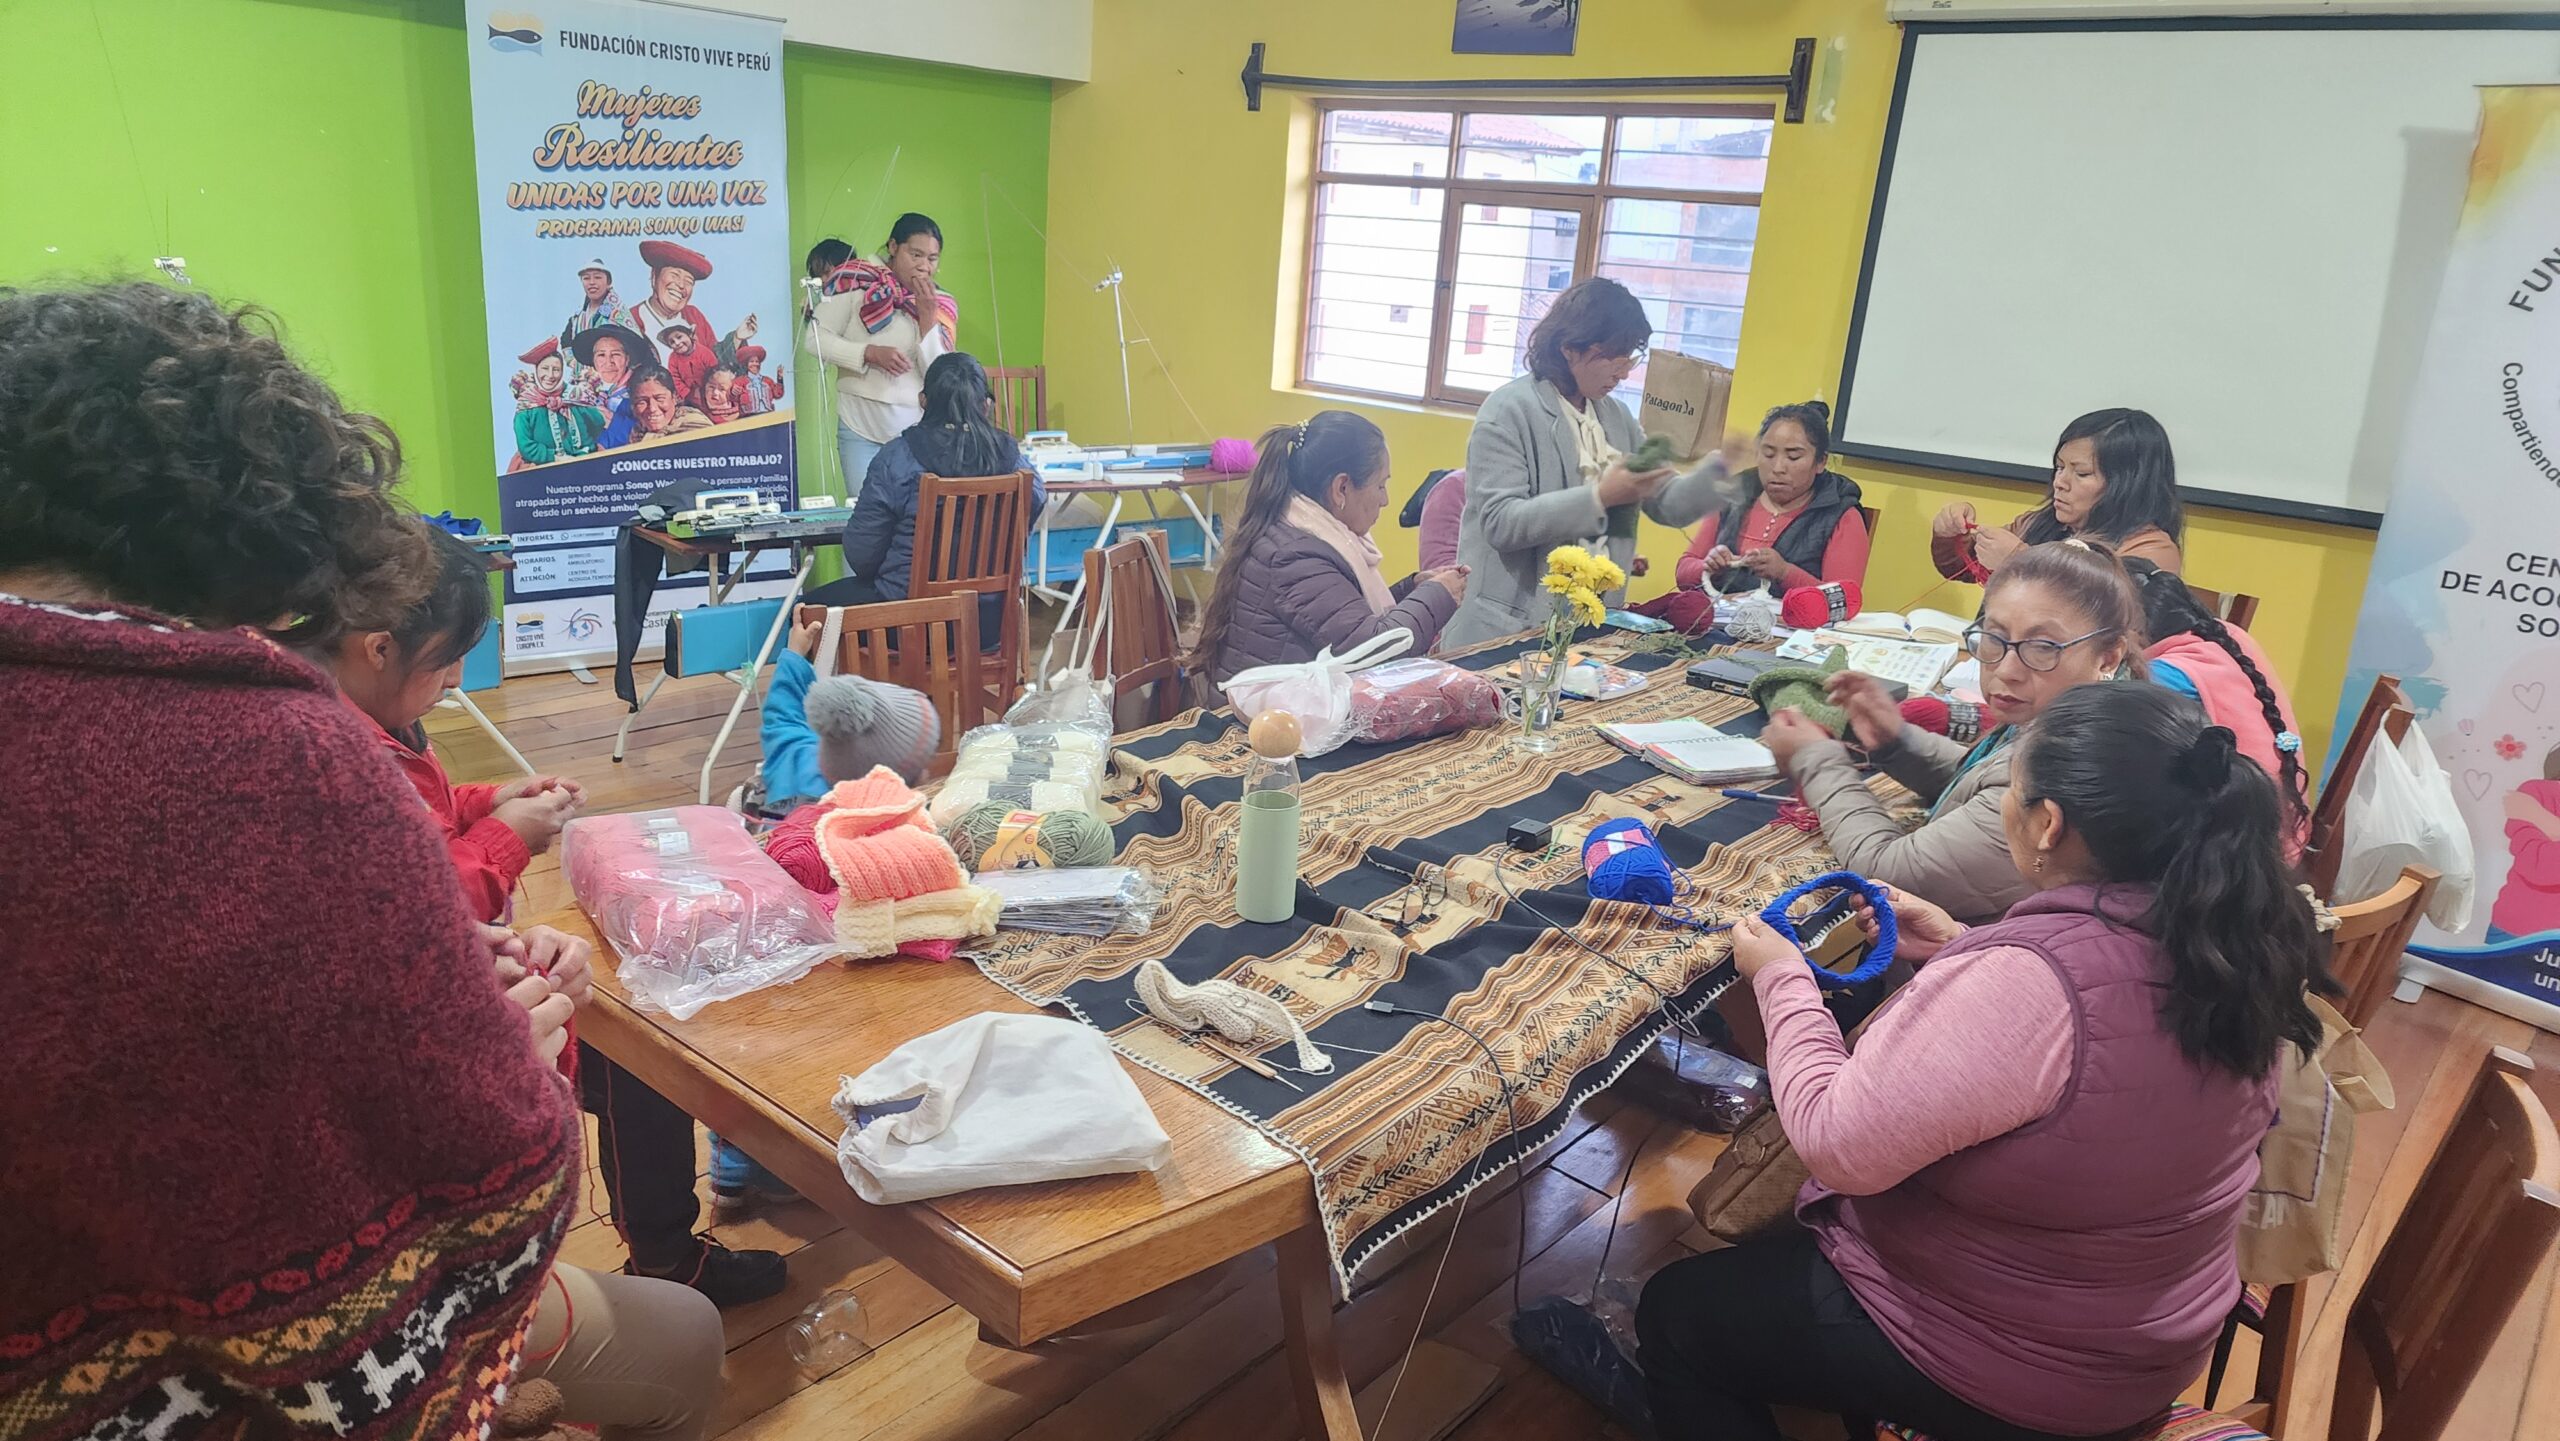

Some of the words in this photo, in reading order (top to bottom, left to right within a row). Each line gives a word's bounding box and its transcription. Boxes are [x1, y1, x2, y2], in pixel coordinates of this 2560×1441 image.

[560, 30, 646, 57] FUNDACIÓN
[650, 41, 700, 63] CRISTO
[703, 47, 734, 67] VIVE
[737, 51, 771, 71] PERÚ
[577, 79, 702, 127] Mujeres
[533, 121, 744, 170] Resilientes
[506, 181, 606, 209] UNIDAS
[610, 181, 662, 209] POR
[667, 181, 718, 207] UNA
[722, 180, 768, 205] VOZ
[536, 218, 640, 237] PROGRAMA
[644, 216, 700, 236] SONQO
[703, 215, 746, 233] WASI
[611, 459, 672, 474] ¿CONOCES
[673, 456, 727, 469] NUESTRO
[728, 453, 783, 467] TRABAJO?
[545, 485, 582, 494] Nuestro
[582, 483, 624, 494] programa
[716, 477, 752, 487] personas
[753, 477, 759, 485] y
[515, 497, 560, 508] atrapadas
[561, 496, 577, 506] por
[578, 494, 609, 504] hechos
[610, 492, 622, 501] de
[532, 508, 559, 518] desde
[561, 507, 573, 516] un
[574, 504, 609, 515] servicio
[517, 533, 554, 543] INFORMES
[518, 556, 556, 566] HORARIOS
[519, 573, 556, 582] ATENCIÓN
[2440, 570, 2482, 594] DE
[2486, 579, 2560, 609] ACO
